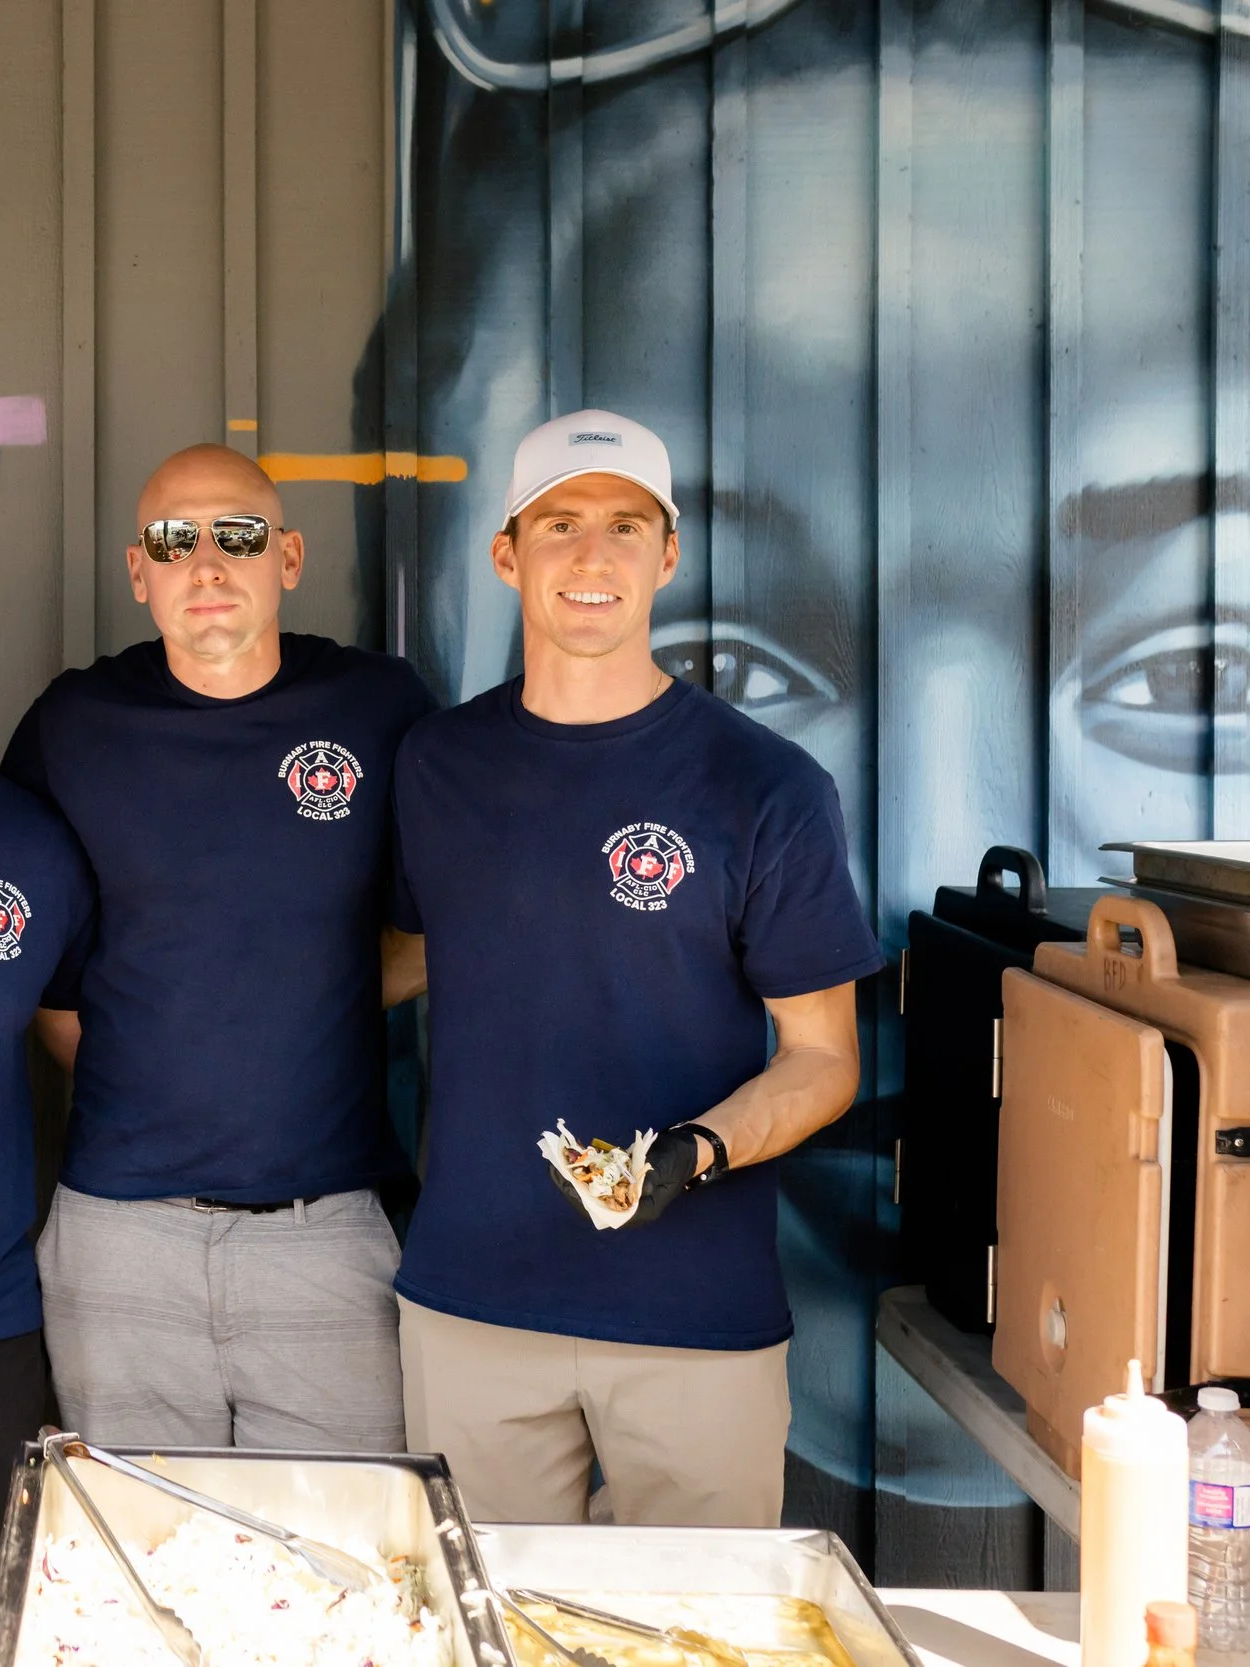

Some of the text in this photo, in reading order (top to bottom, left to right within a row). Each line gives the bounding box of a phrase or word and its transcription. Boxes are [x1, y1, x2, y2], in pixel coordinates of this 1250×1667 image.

[574, 433, 617, 443] Titleist
[278, 740, 364, 779] BURNABY FIRE FIGHTERS
[297, 806, 350, 820] LOCAL 323
[601, 822, 695, 874] BURNABY FIRE FIGHTERS
[4, 882, 32, 919] FIGHTERS
[610, 888, 668, 911] LOCAL 323
[9, 946, 22, 959] 323
